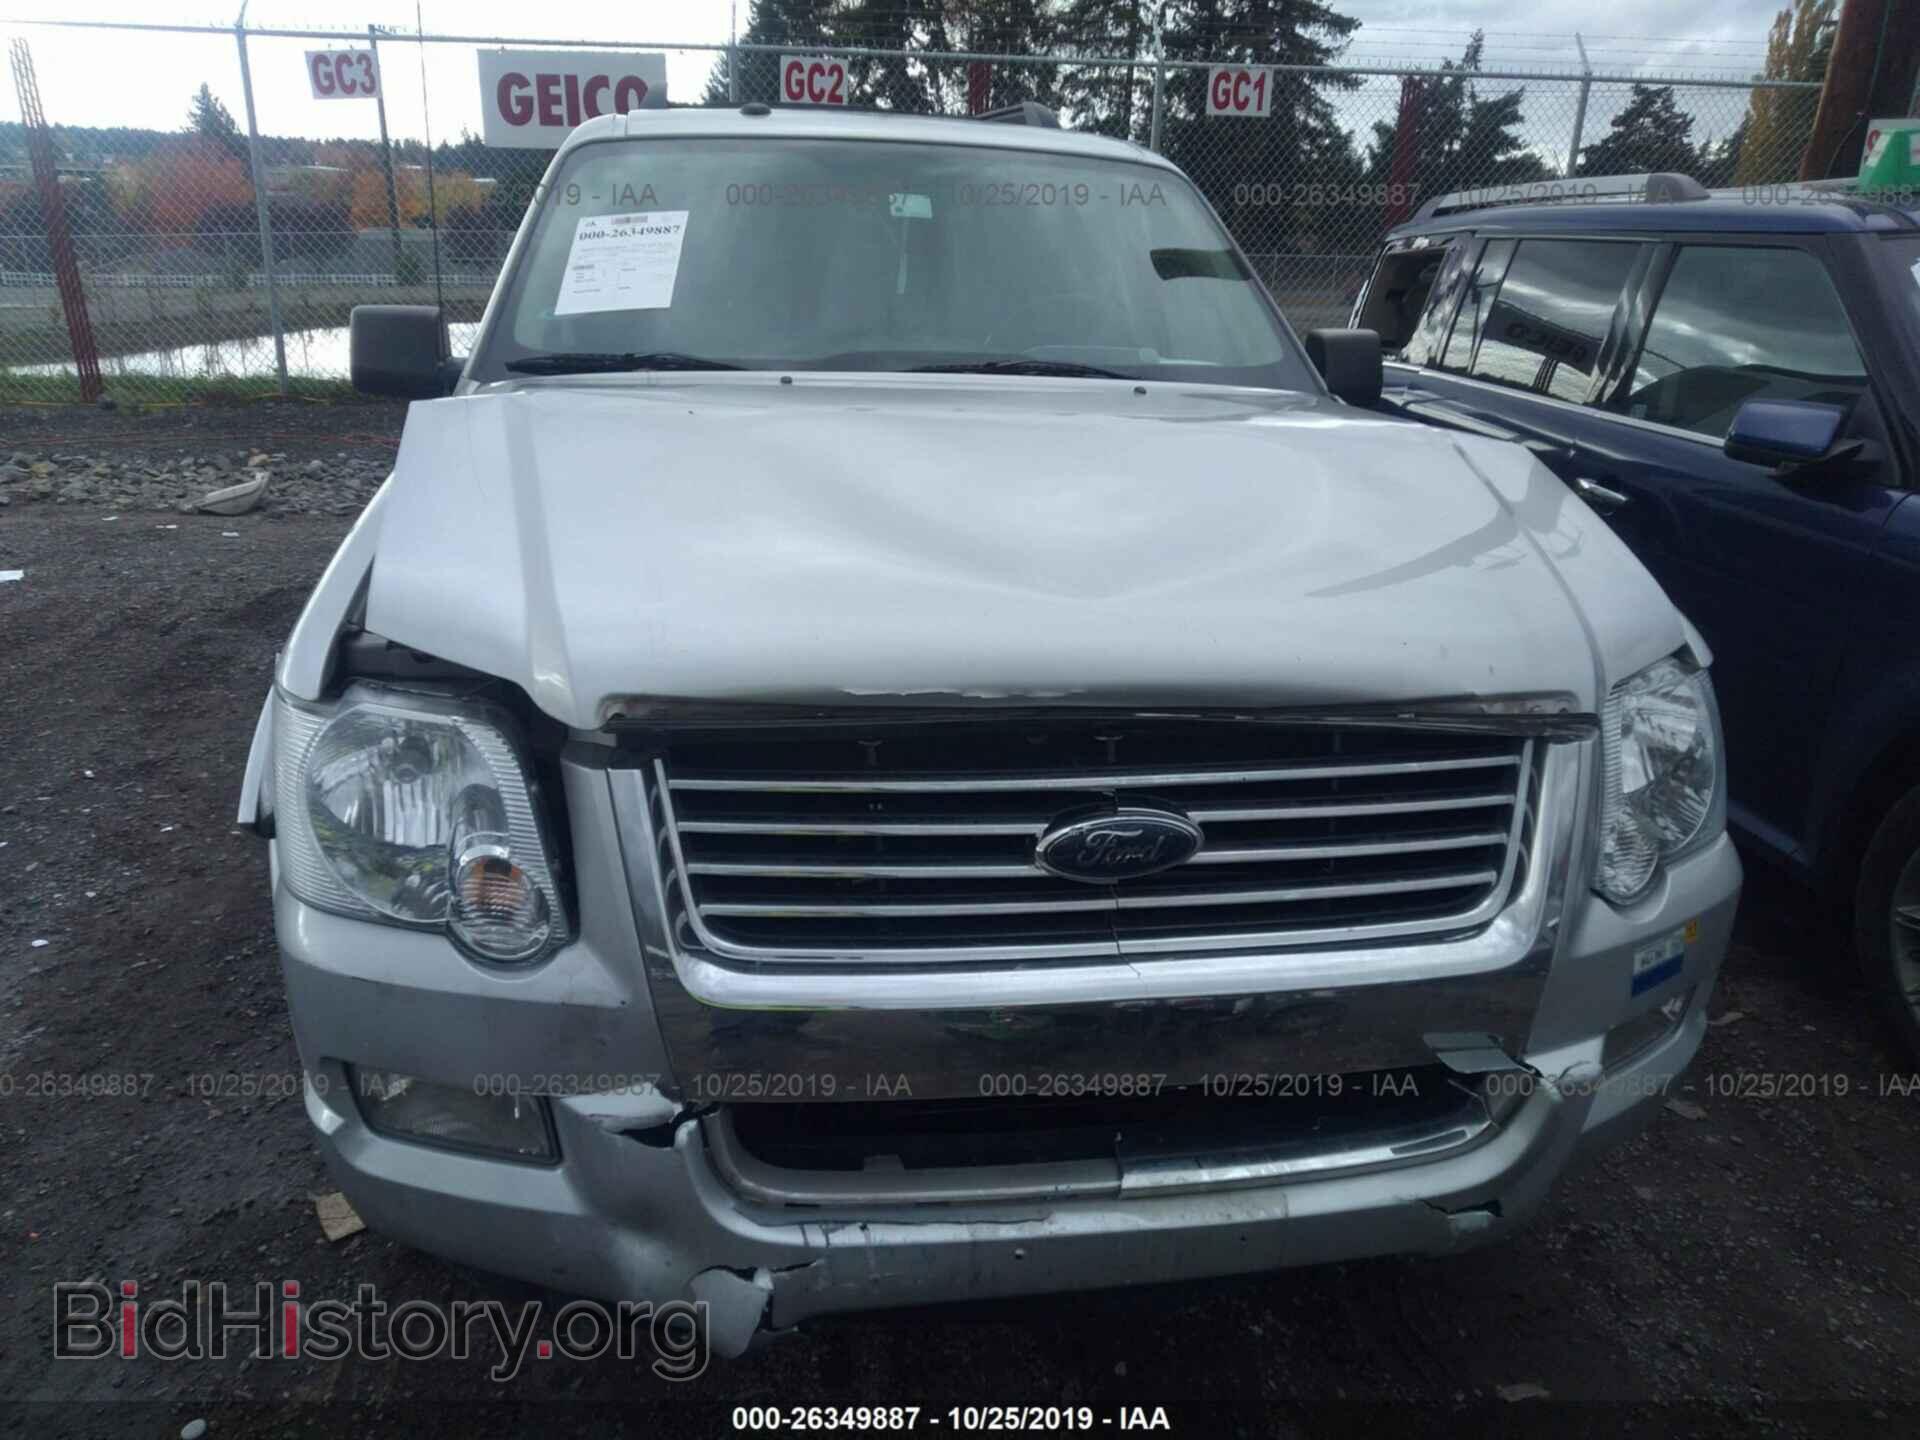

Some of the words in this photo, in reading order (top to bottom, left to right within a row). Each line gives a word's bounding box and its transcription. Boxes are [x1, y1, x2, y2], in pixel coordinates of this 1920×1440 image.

[311, 53, 376, 95] GC3
[785, 60, 843, 104] GC2
[1212, 70, 1265, 112] GC1
[497, 72, 648, 127] GEICO
[579, 225, 681, 241] 000-26349887
[1077, 829, 1166, 866] Ford
